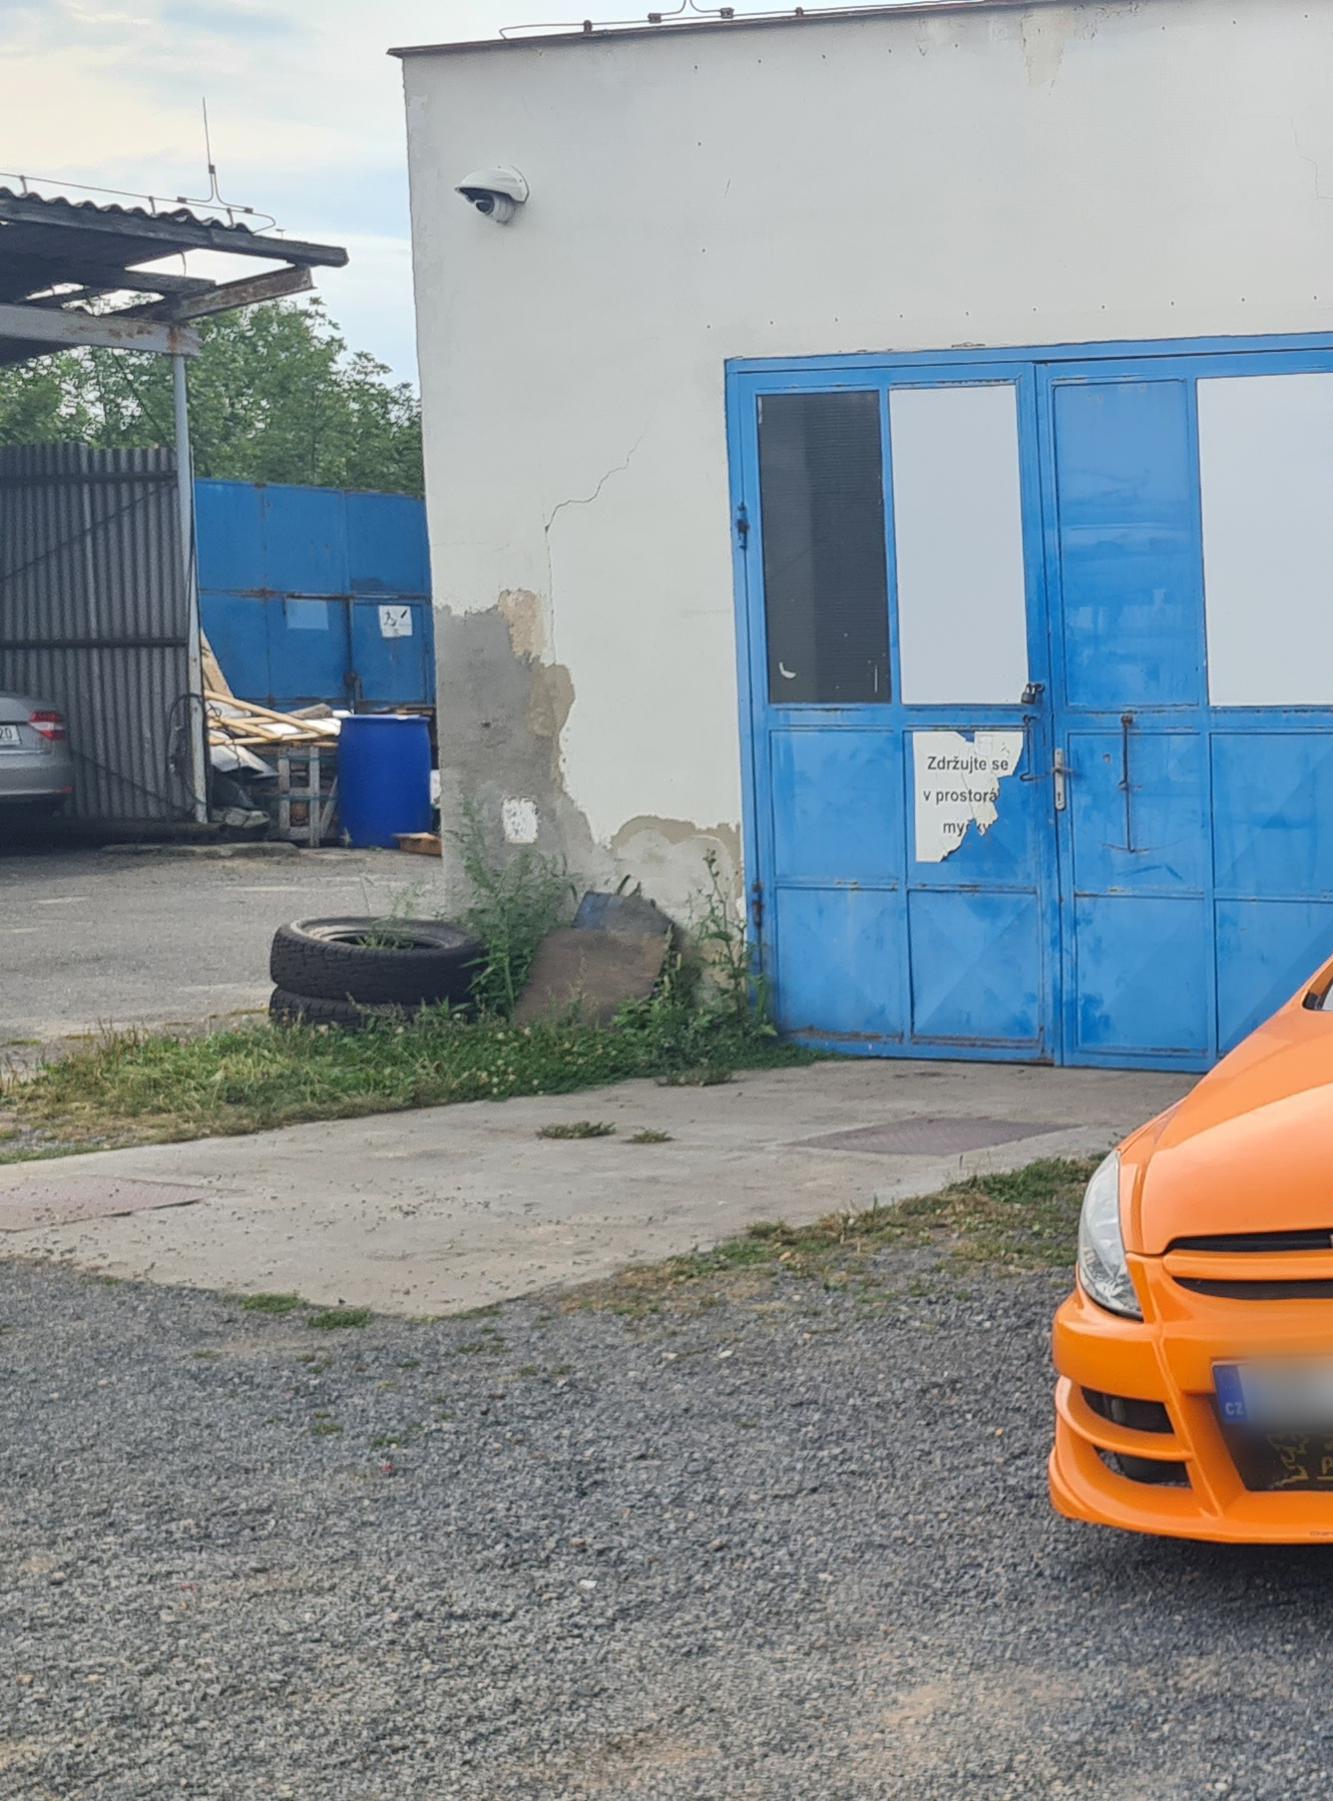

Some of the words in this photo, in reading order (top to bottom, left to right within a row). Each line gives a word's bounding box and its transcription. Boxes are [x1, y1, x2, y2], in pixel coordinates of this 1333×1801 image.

[927, 755, 987, 774] Zdržujte
[991, 758, 1009, 772] se
[923, 791, 931, 801] v
[1224, 1401, 1245, 1416] CZ
